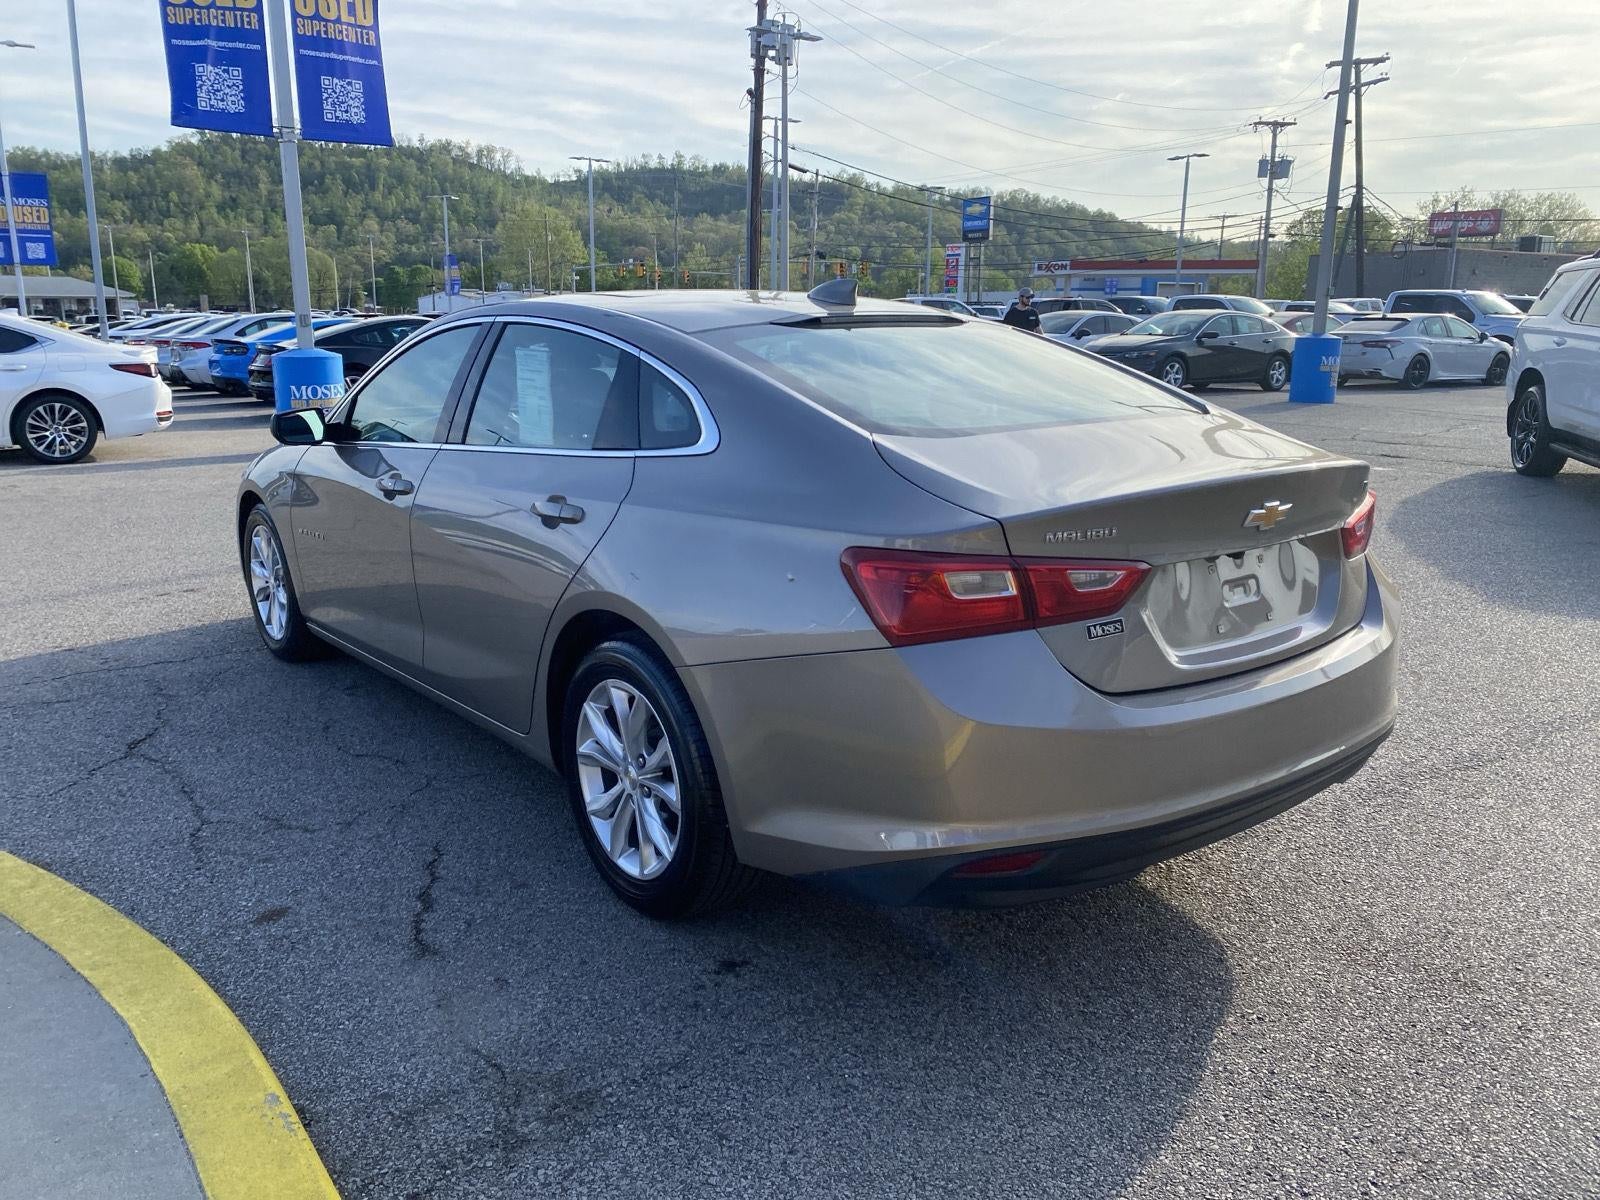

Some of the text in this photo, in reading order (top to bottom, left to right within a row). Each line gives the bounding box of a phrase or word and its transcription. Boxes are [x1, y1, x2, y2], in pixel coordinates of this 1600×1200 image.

[166, 6, 260, 30] SUPERCENTER
[296, 18, 377, 47] SUPERCENTER
[171, 38, 261, 50] mosesusedsupercenter.com
[299, 48, 380, 66] mosesusedsupercenter.com
[12, 197, 48, 207] MOSES
[14, 205, 49, 224] USED
[1431, 213, 1474, 233] Weny's
[1037, 262, 1068, 273] EXXON
[290, 384, 345, 400] MOSES
[1045, 527, 1119, 543] MALIBU
[1089, 622, 1122, 638] MOSES
